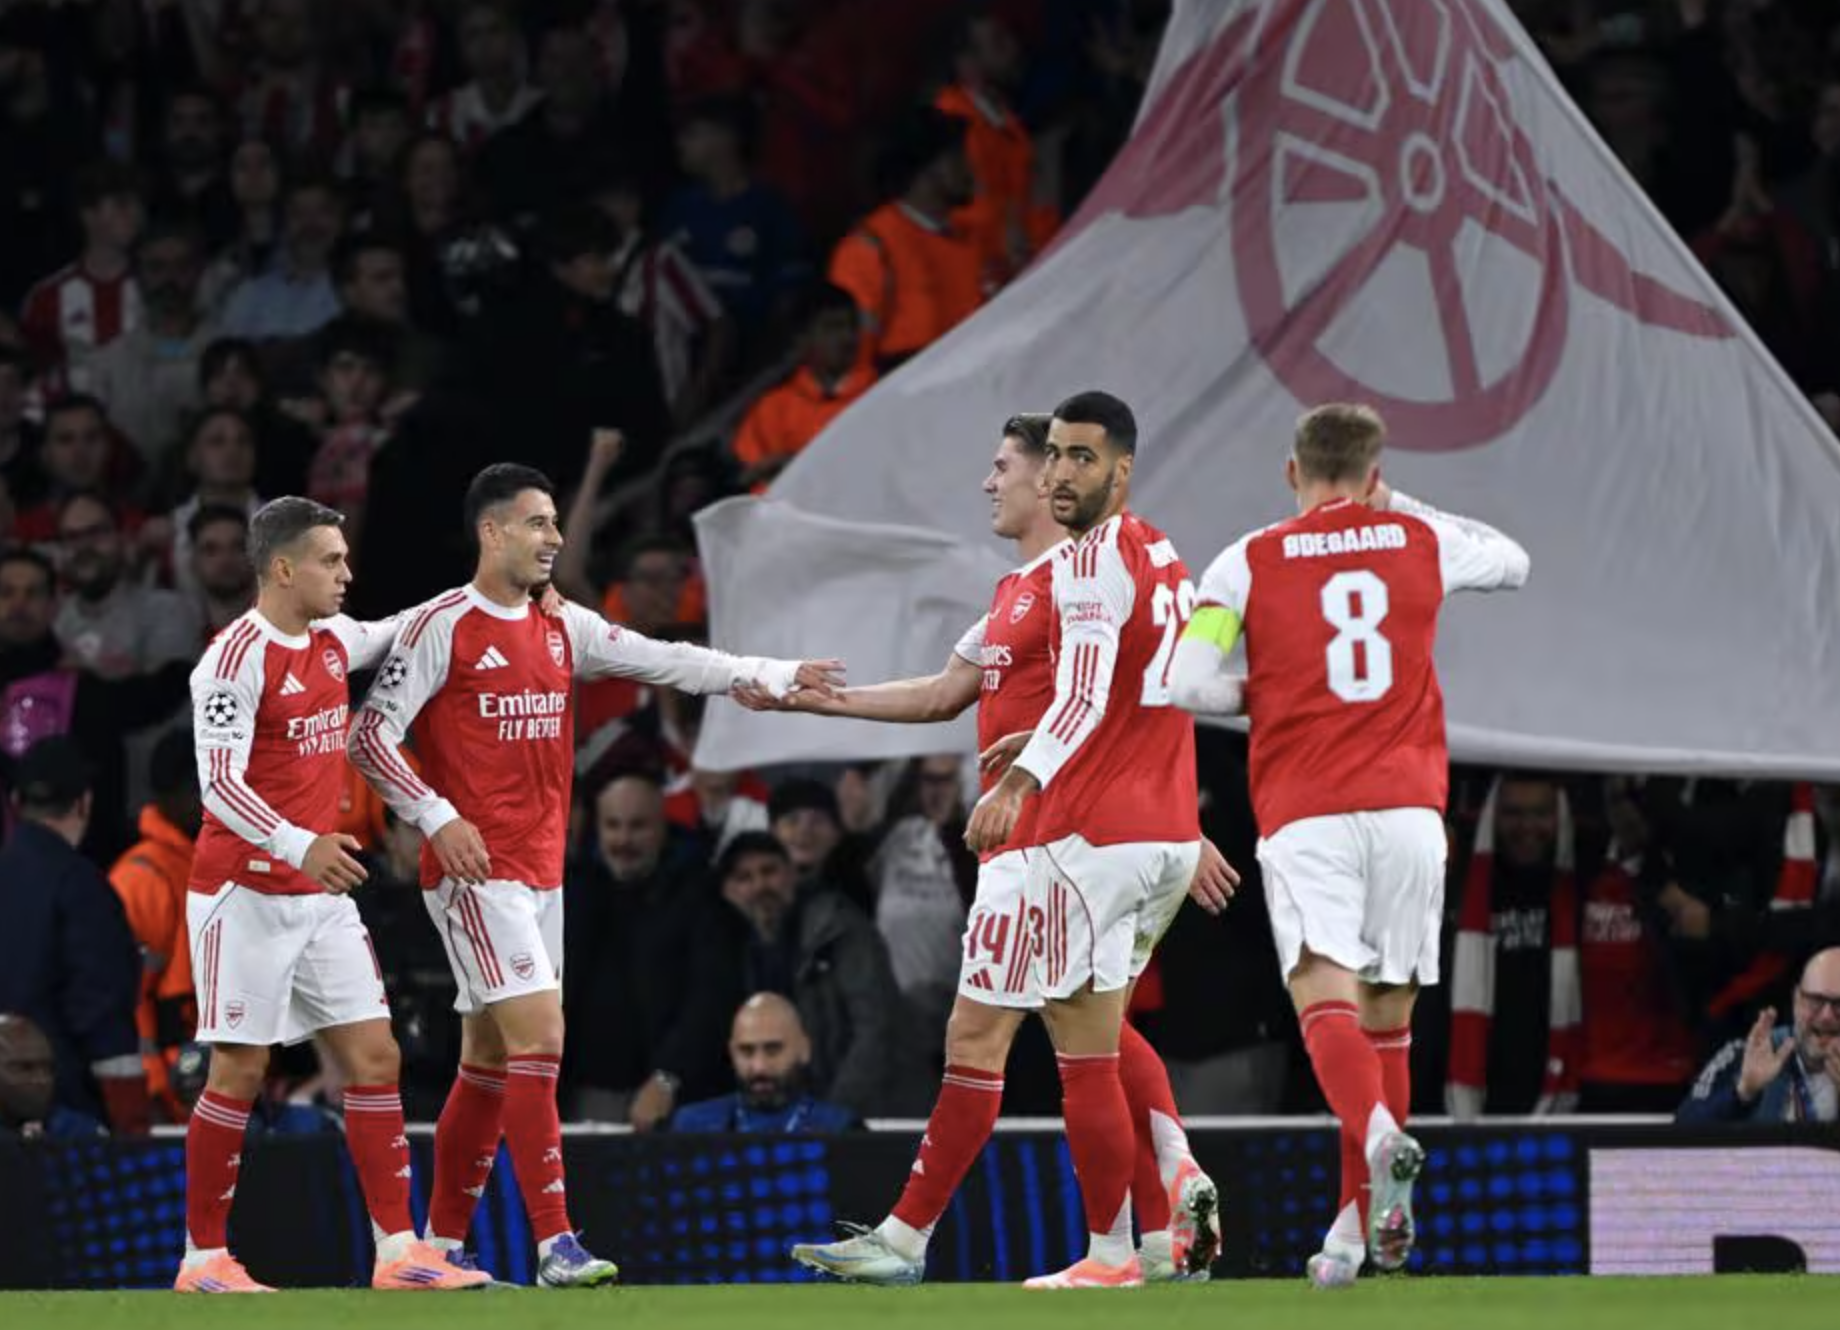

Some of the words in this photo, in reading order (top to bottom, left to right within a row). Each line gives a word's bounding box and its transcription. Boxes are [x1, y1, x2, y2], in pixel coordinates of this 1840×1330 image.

[1321, 569, 1393, 704] 8
[498, 719, 524, 741] FLY
[967, 911, 1011, 966] 14
[1028, 905, 1045, 958] 3
